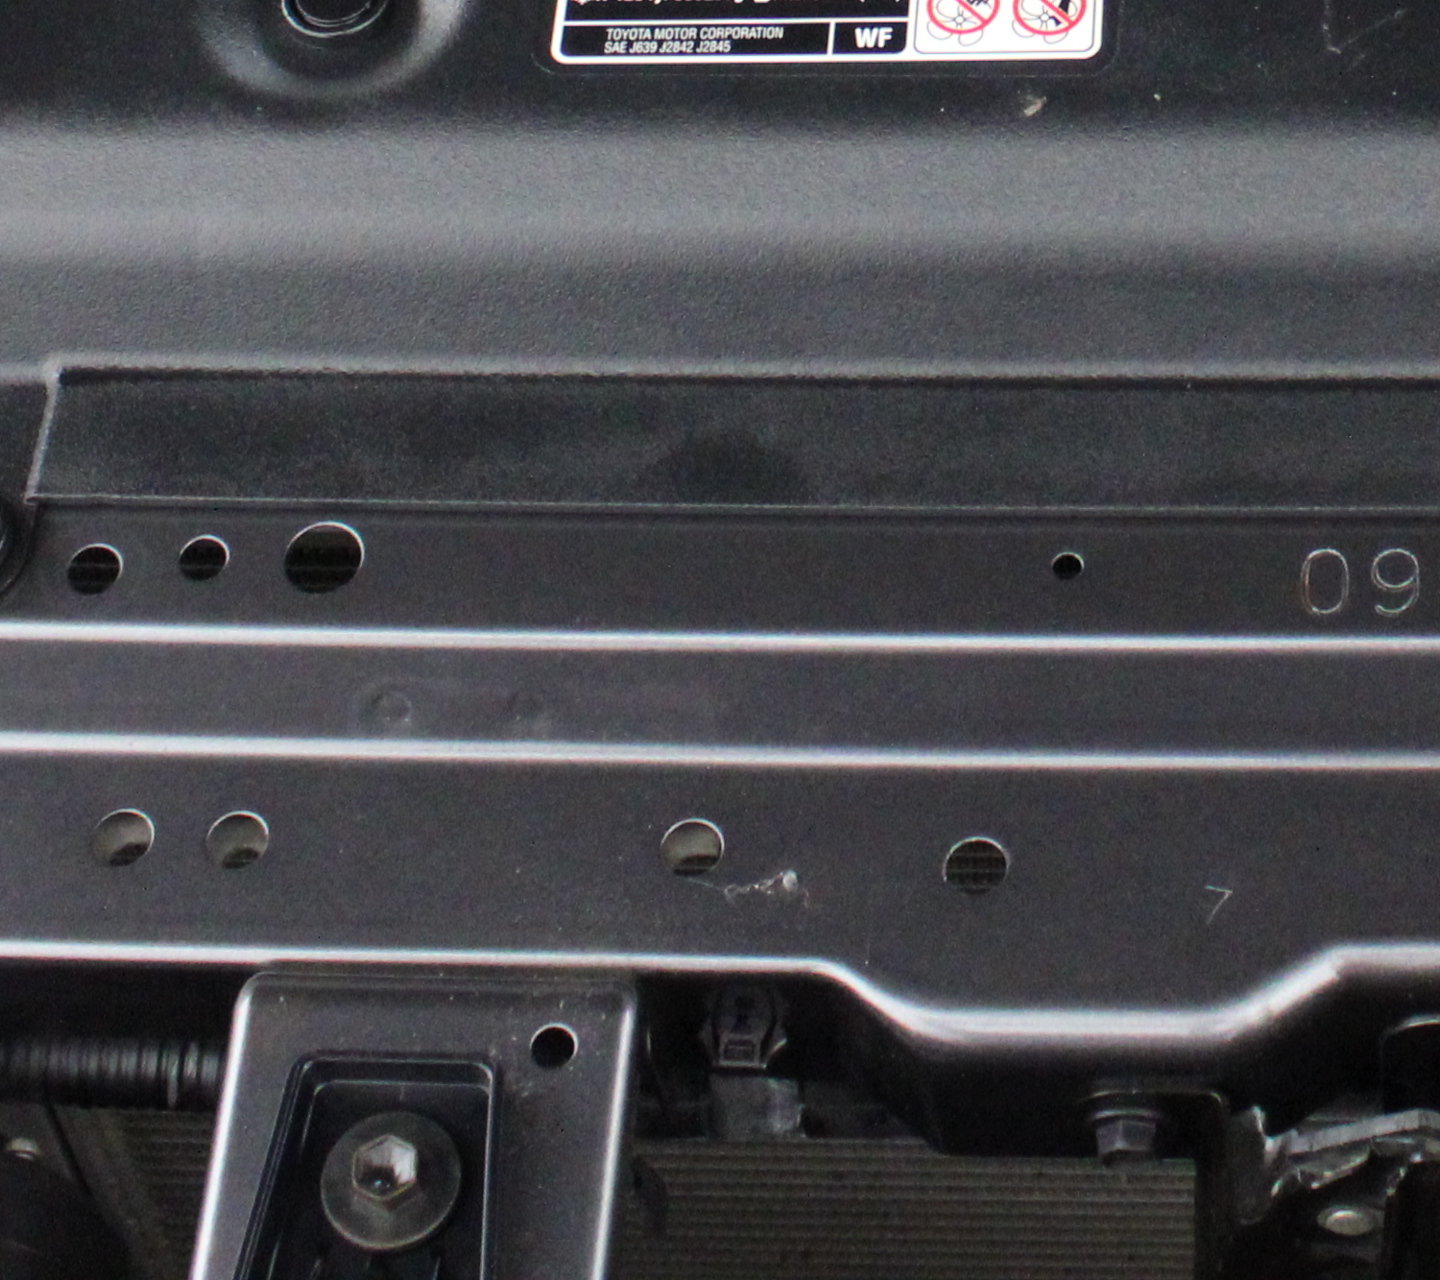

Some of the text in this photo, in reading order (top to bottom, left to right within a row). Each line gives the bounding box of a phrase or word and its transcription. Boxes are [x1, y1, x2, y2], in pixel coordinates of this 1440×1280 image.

[605, 26, 785, 41] TOYOTA MOTOR CORPORATION
[854, 27, 894, 48] WF
[603, 40, 732, 53] SAE J639 J2842 J2845
